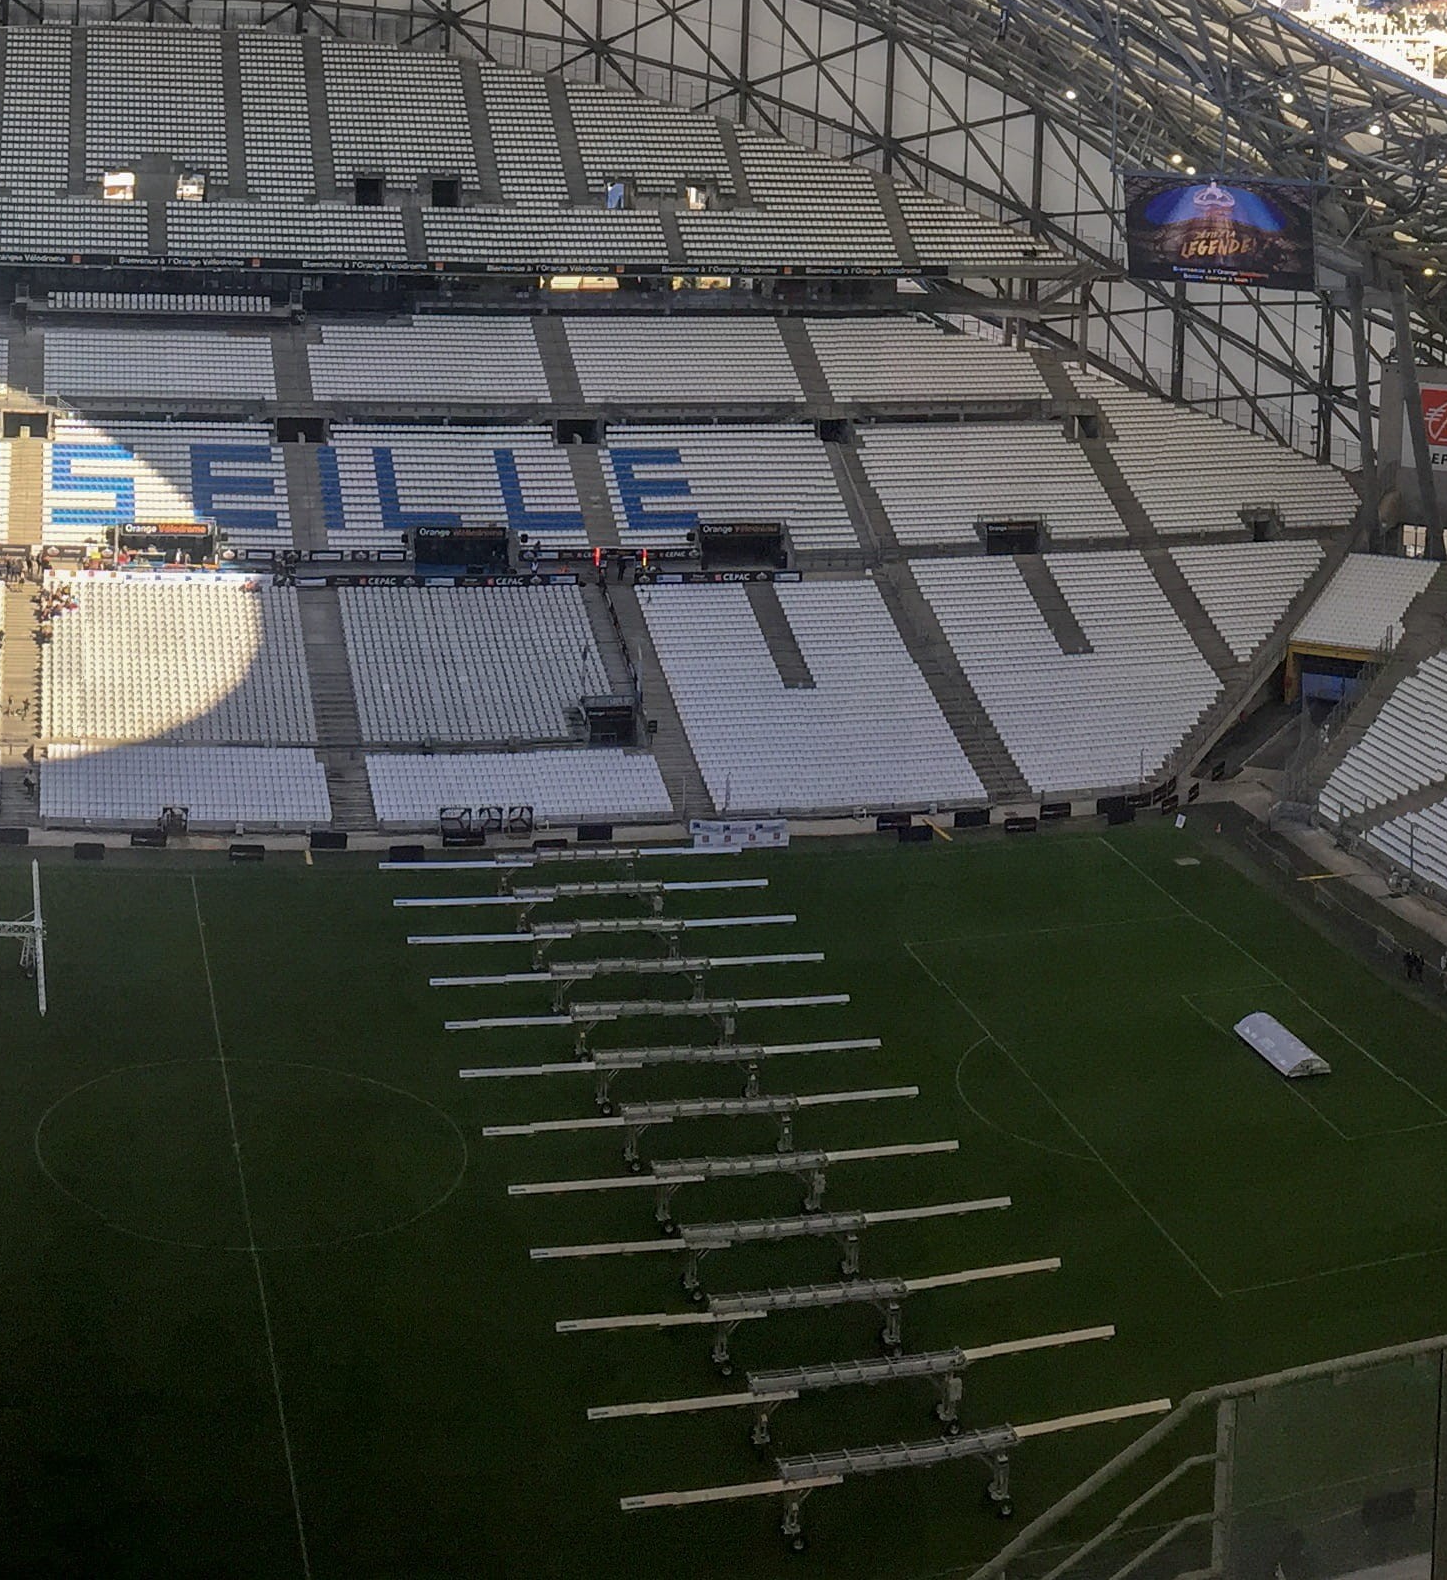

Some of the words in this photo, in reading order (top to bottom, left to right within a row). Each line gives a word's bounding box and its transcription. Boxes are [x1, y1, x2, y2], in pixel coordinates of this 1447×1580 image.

[125, 524, 158, 534] Orange
[419, 527, 451, 537] Orange
[702, 524, 733, 535] Orange
[368, 577, 396, 585] CEPAC
[496, 577, 524, 585] CEPAC
[723, 573, 750, 581] CEPAC
